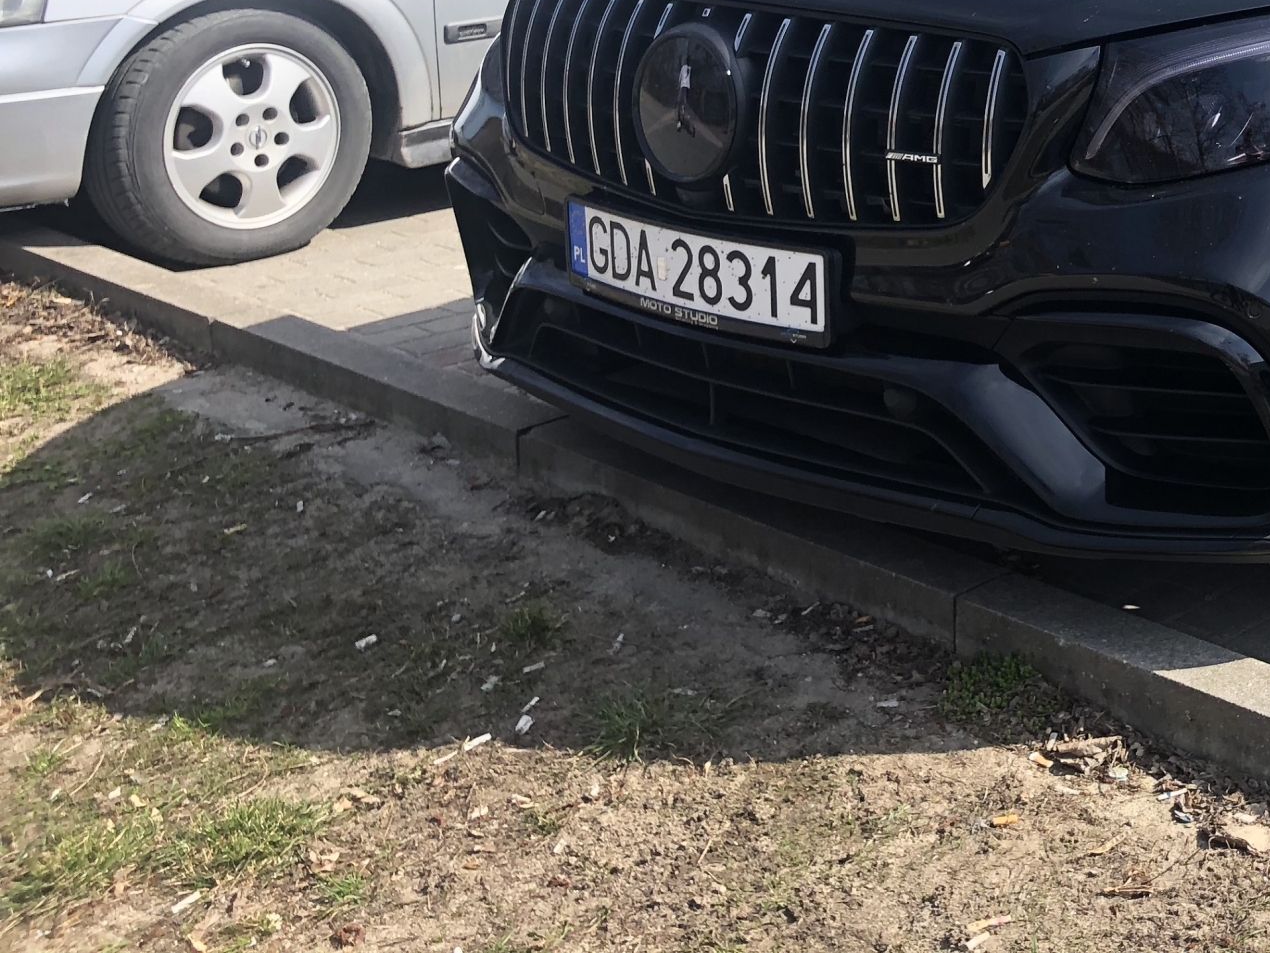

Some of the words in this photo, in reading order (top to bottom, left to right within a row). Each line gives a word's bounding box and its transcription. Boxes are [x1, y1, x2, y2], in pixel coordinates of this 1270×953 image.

[902, 153, 938, 163] AMG
[573, 245, 586, 264] PL
[588, 215, 657, 292] GDA
[671, 238, 818, 325] 28314
[640, 297, 672, 315] MOTO
[674, 306, 719, 326] STUDIO
